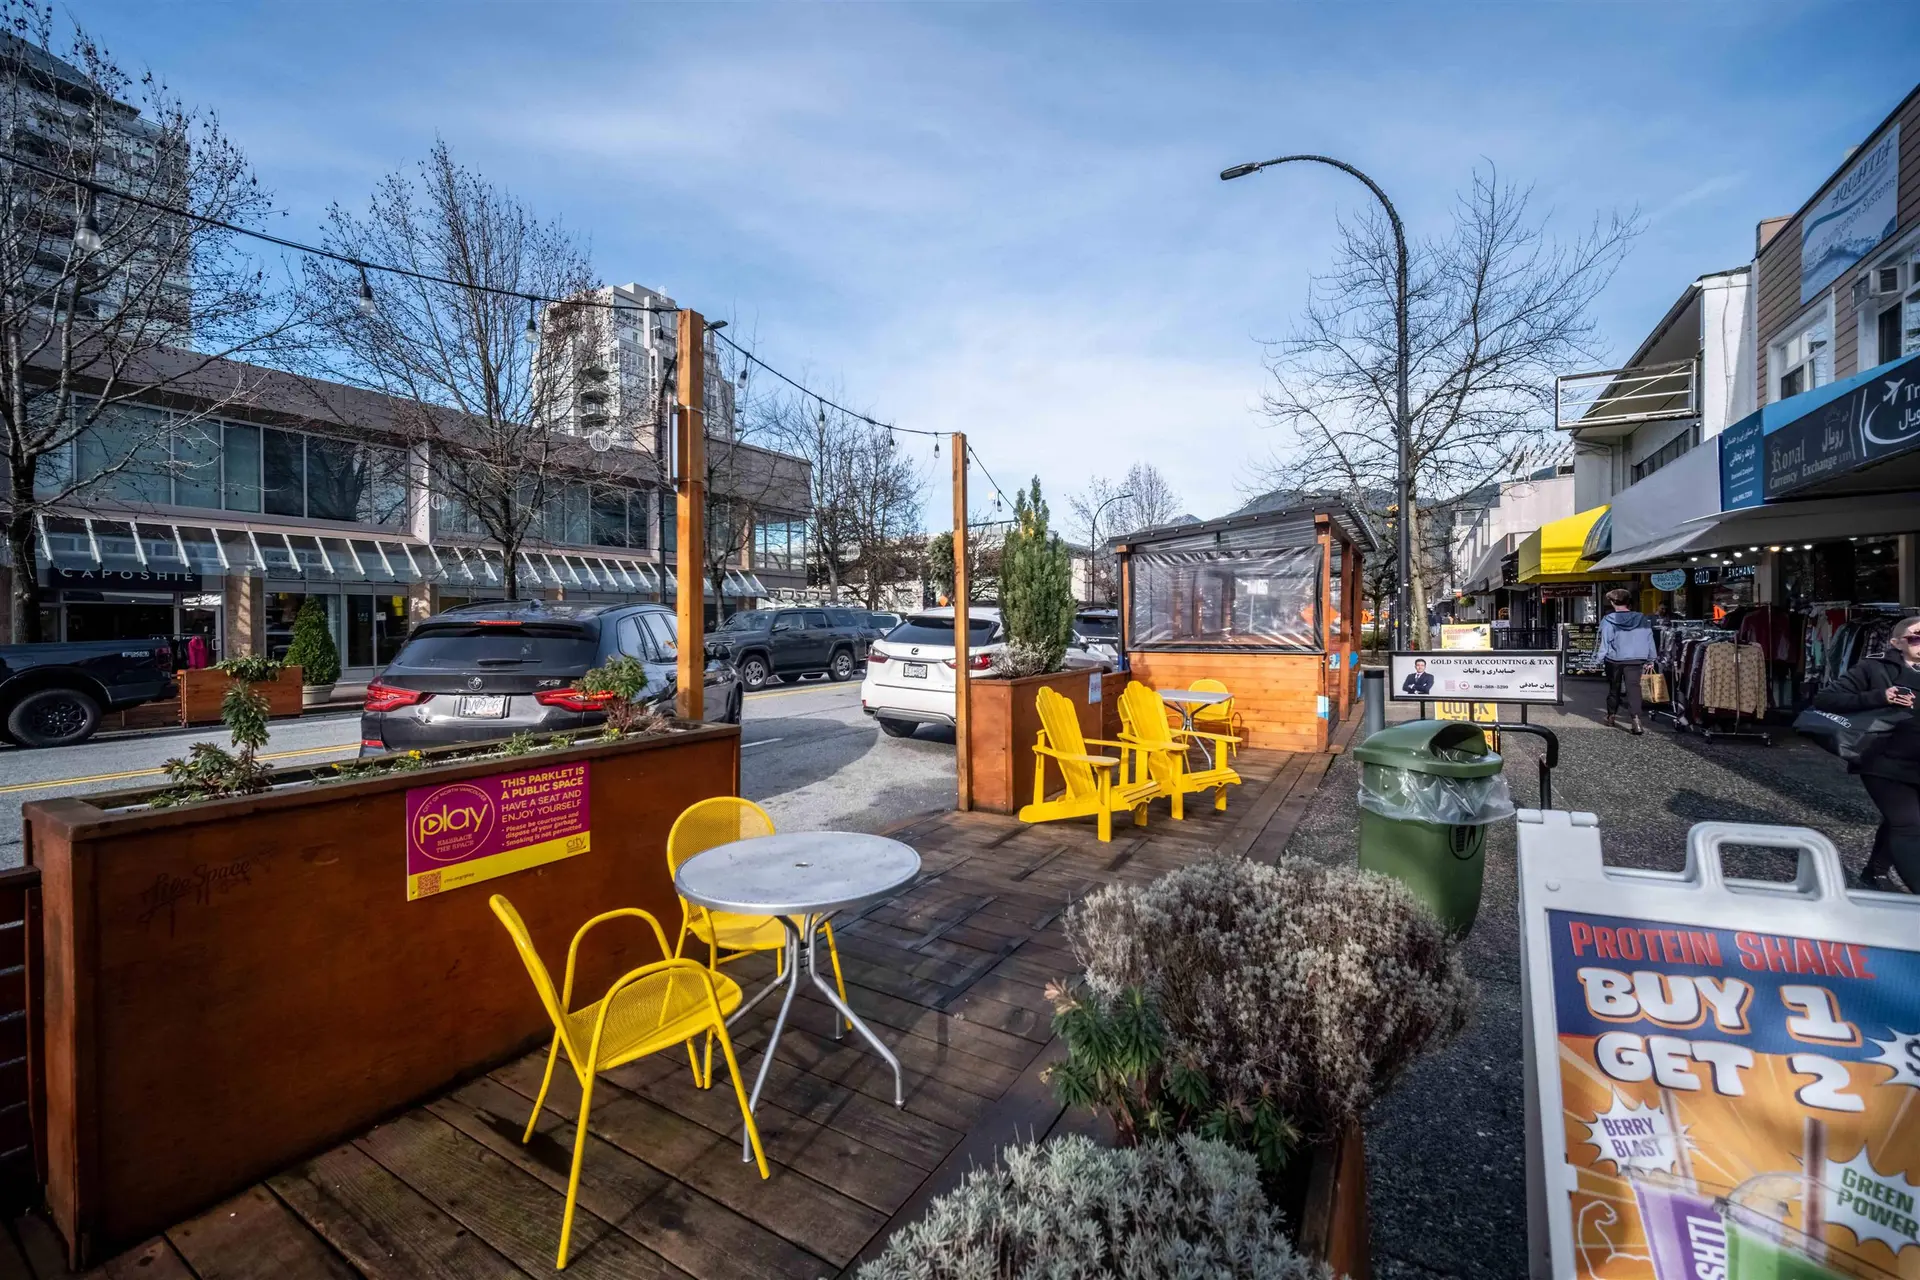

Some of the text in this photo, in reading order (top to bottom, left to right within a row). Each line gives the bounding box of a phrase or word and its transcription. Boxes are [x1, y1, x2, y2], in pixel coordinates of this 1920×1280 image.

[1771, 438, 1805, 473] Royal
[1770, 471, 1797, 489] Currency
[1802, 456, 1837, 476] Exchange
[62, 568, 194, 581] CAPOSHIE
[1694, 570, 1710, 584] GOLD
[1728, 565, 1755, 578] EXCHANG
[1442, 701, 1489, 715] QUIK
[501, 767, 584, 788] THIS PARKLET IS
[501, 777, 583, 800] A PUBLIC SPACE
[502, 800, 527, 812] HAVE
[538, 794, 560, 804] SEAT
[562, 790, 581, 800] AND
[502, 799, 581, 822] ENJOY YOURSELF
[420, 804, 488, 843] play
[506, 824, 526, 832] Please
[537, 815, 567, 825] courteous
[506, 830, 528, 838] dispose
[539, 824, 552, 832] your
[554, 819, 577, 828] garbage
[506, 836, 533, 846] Smoking
[553, 824, 582, 836] permitted
[567, 836, 584, 849] city
[1568, 921, 1876, 979] PROTEIN SHAKE
[1577, 967, 1863, 1047] BUY 1
[1594, 1031, 1754, 1096] GET
[1787, 1053, 1865, 1112] 2
[1601, 1117, 1655, 1136] BERRY
[1611, 1138, 1664, 1158] BLAST
[1841, 1167, 1914, 1214] GREEN
[1837, 1187, 1920, 1240] POWER
